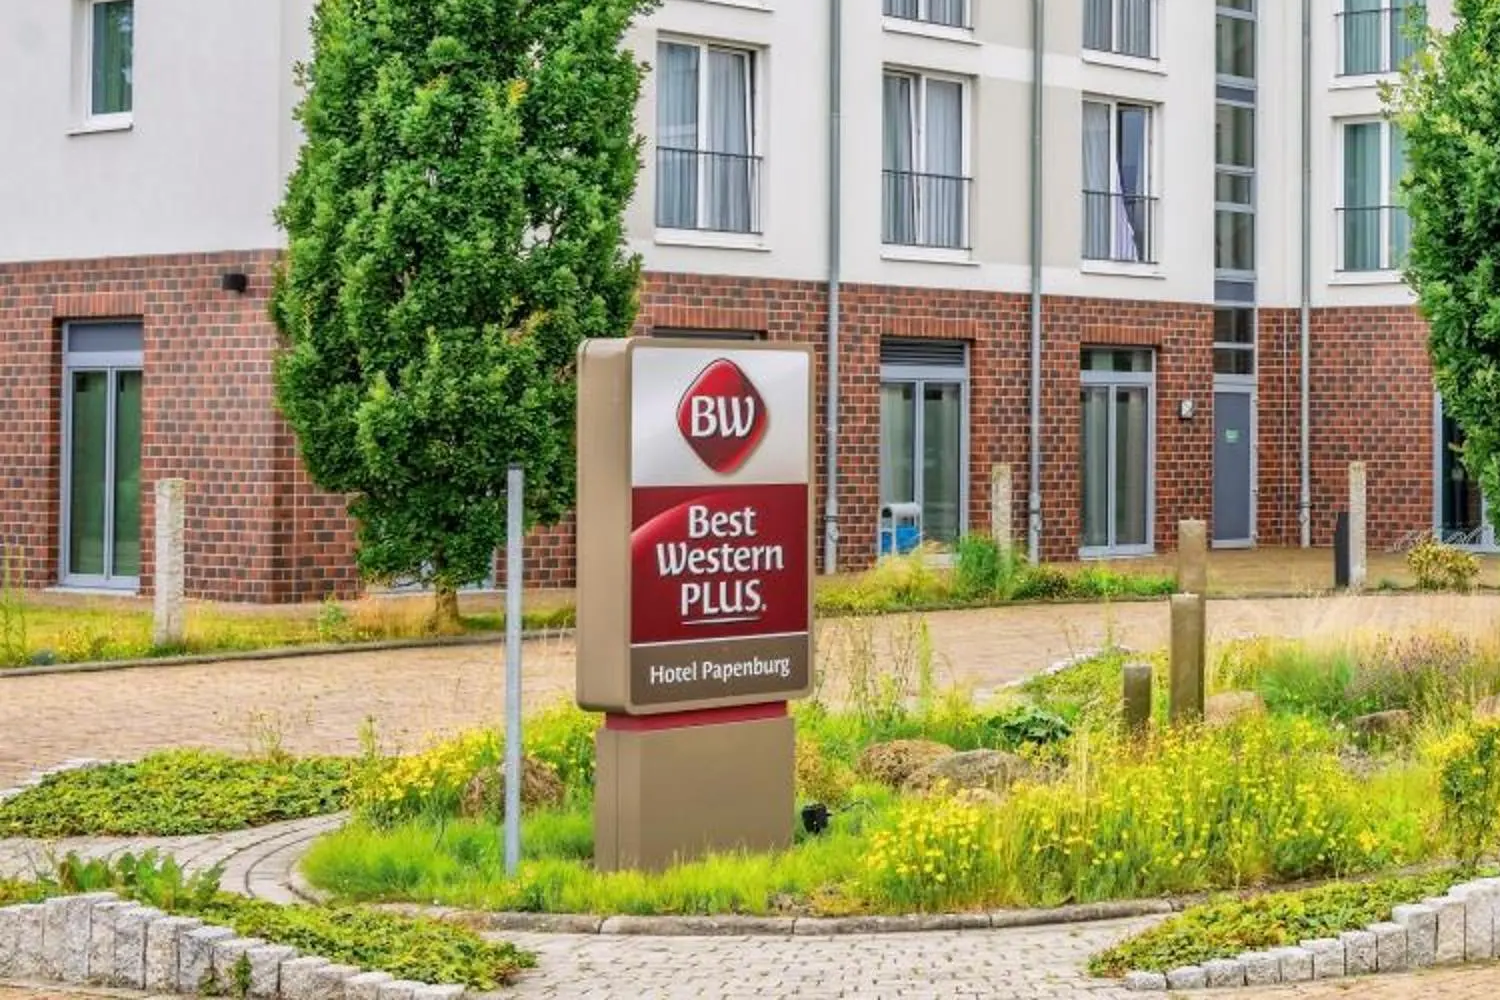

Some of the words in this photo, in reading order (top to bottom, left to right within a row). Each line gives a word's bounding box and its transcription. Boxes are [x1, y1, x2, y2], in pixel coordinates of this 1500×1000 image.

[691, 396, 754, 438] BW
[688, 505, 757, 539] Best
[656, 542, 785, 577] Western
[650, 661, 697, 685] Hotel
[702, 656, 791, 682] Papenburg
